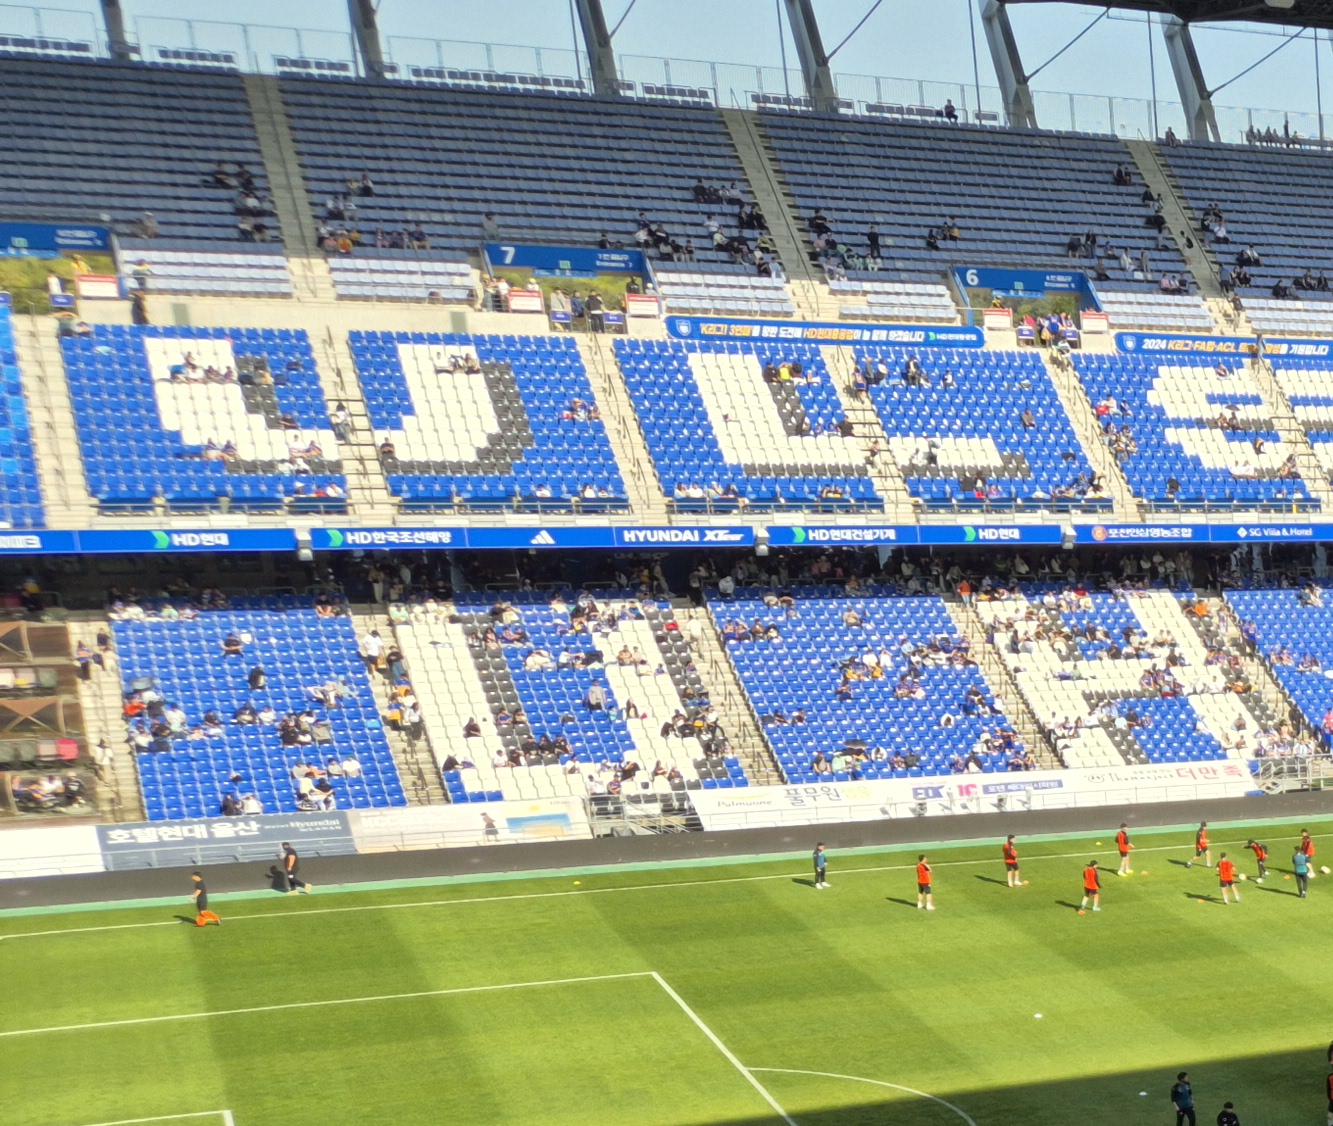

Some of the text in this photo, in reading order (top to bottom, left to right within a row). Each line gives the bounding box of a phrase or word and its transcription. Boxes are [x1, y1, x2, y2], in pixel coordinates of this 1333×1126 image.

[500, 247, 516, 264] 7
[965, 269, 980, 286] 6
[1141, 338, 1167, 350] 2024
[346, 531, 451, 545] HD한국조선해양
[623, 529, 700, 542] HYUNDAI
[807, 528, 896, 541] HD현대건설기계
[784, 786, 842, 807] 풀무원
[716, 800, 772, 808] Pulmuone
[289, 817, 341, 829] Hyundai
[107, 820, 260, 845] 호텔현대 울산
